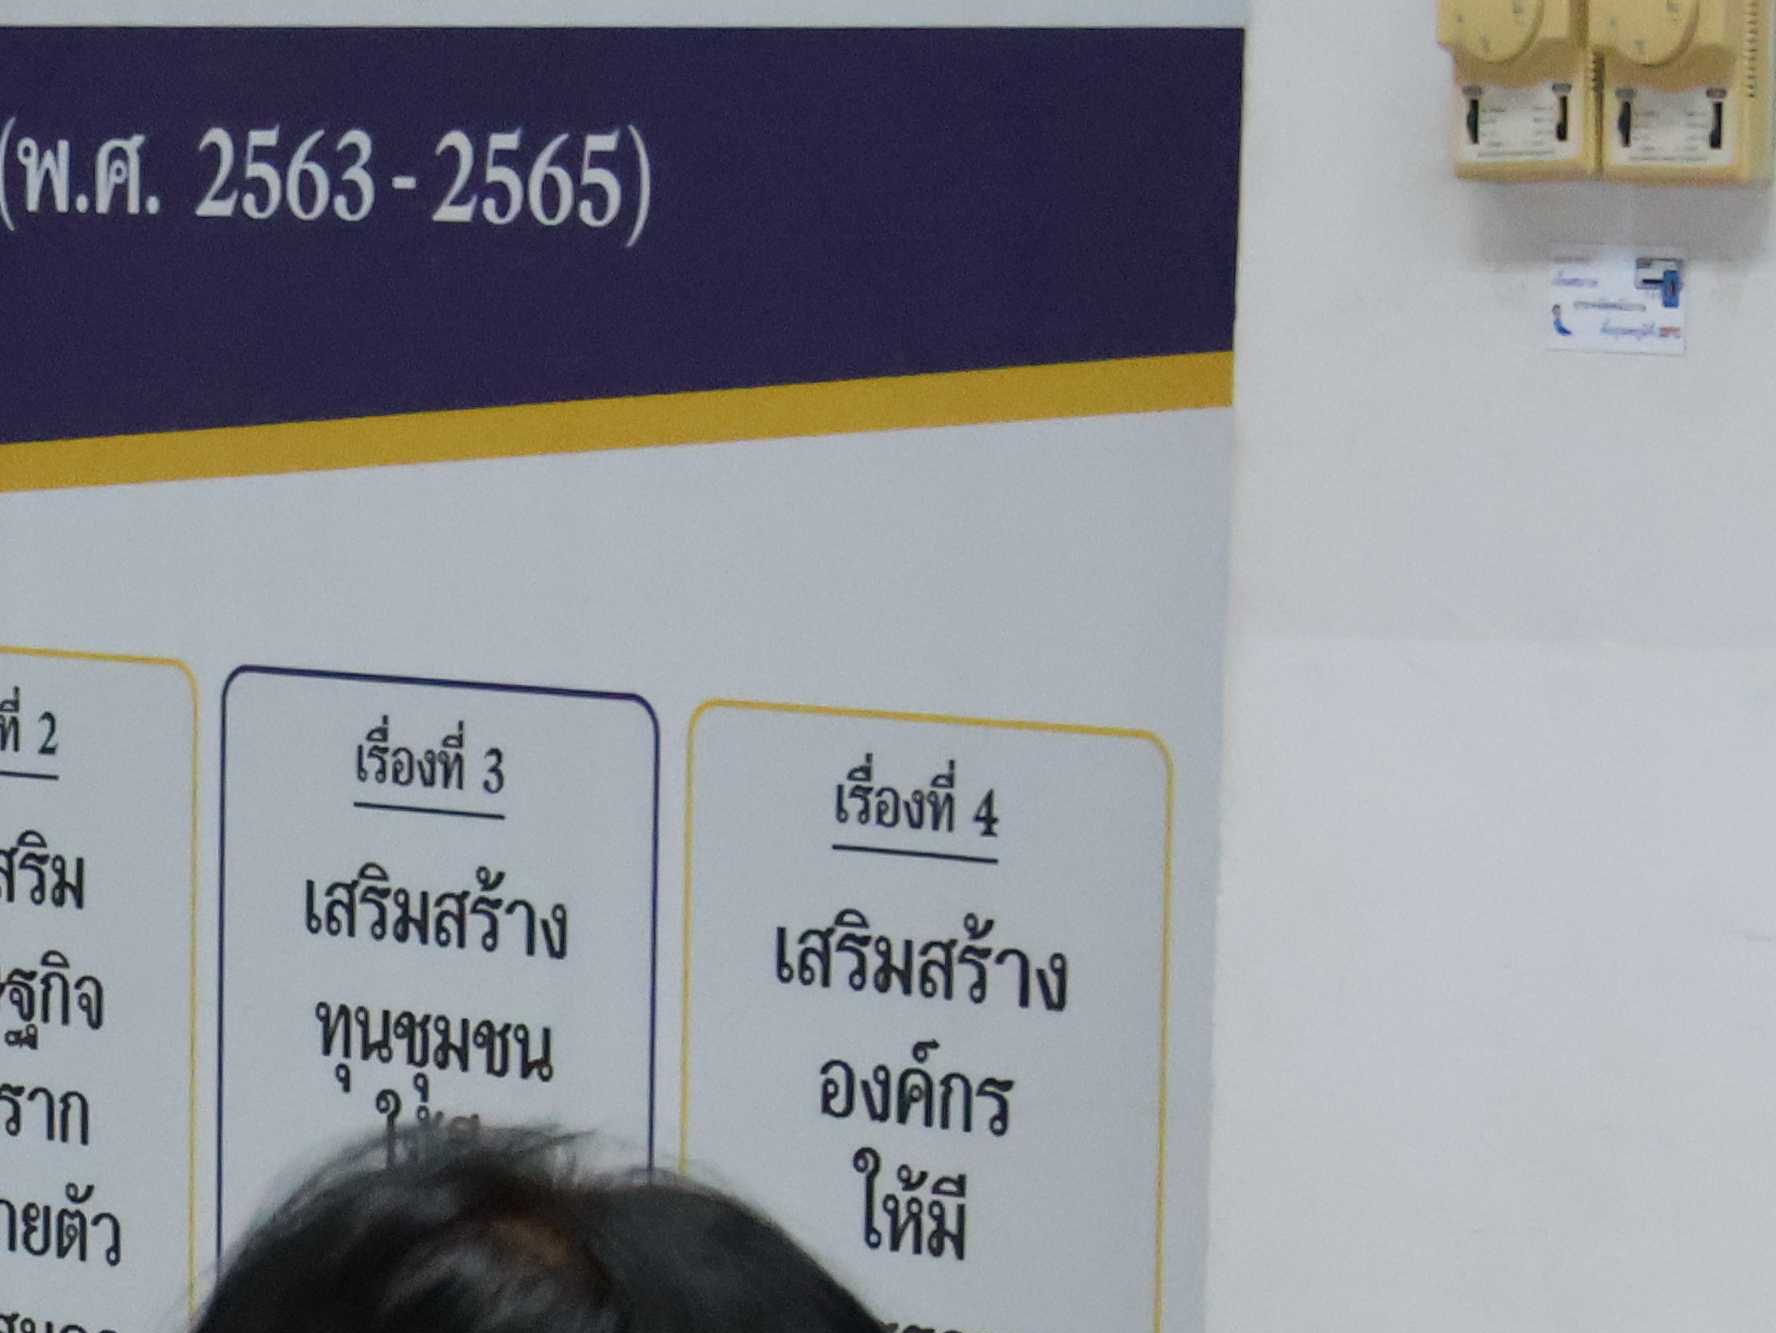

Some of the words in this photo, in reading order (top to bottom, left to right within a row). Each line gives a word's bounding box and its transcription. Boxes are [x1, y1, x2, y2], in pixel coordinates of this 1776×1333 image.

[37, 710, 58, 756] 2
[356, 714, 465, 791] เรื่องที่
[482, 747, 505, 795] 3
[835, 752, 956, 833] เรื่องที่
[972, 788, 1000, 838] 4
[305, 861, 568, 960] เสริมสร้าง
[775, 908, 1068, 1013] เสริมสร้าง
[314, 1001, 554, 1107] ทุนชุมชน
[819, 1038, 1015, 1138] องค์กร
[852, 1146, 967, 1262] ให้มี
